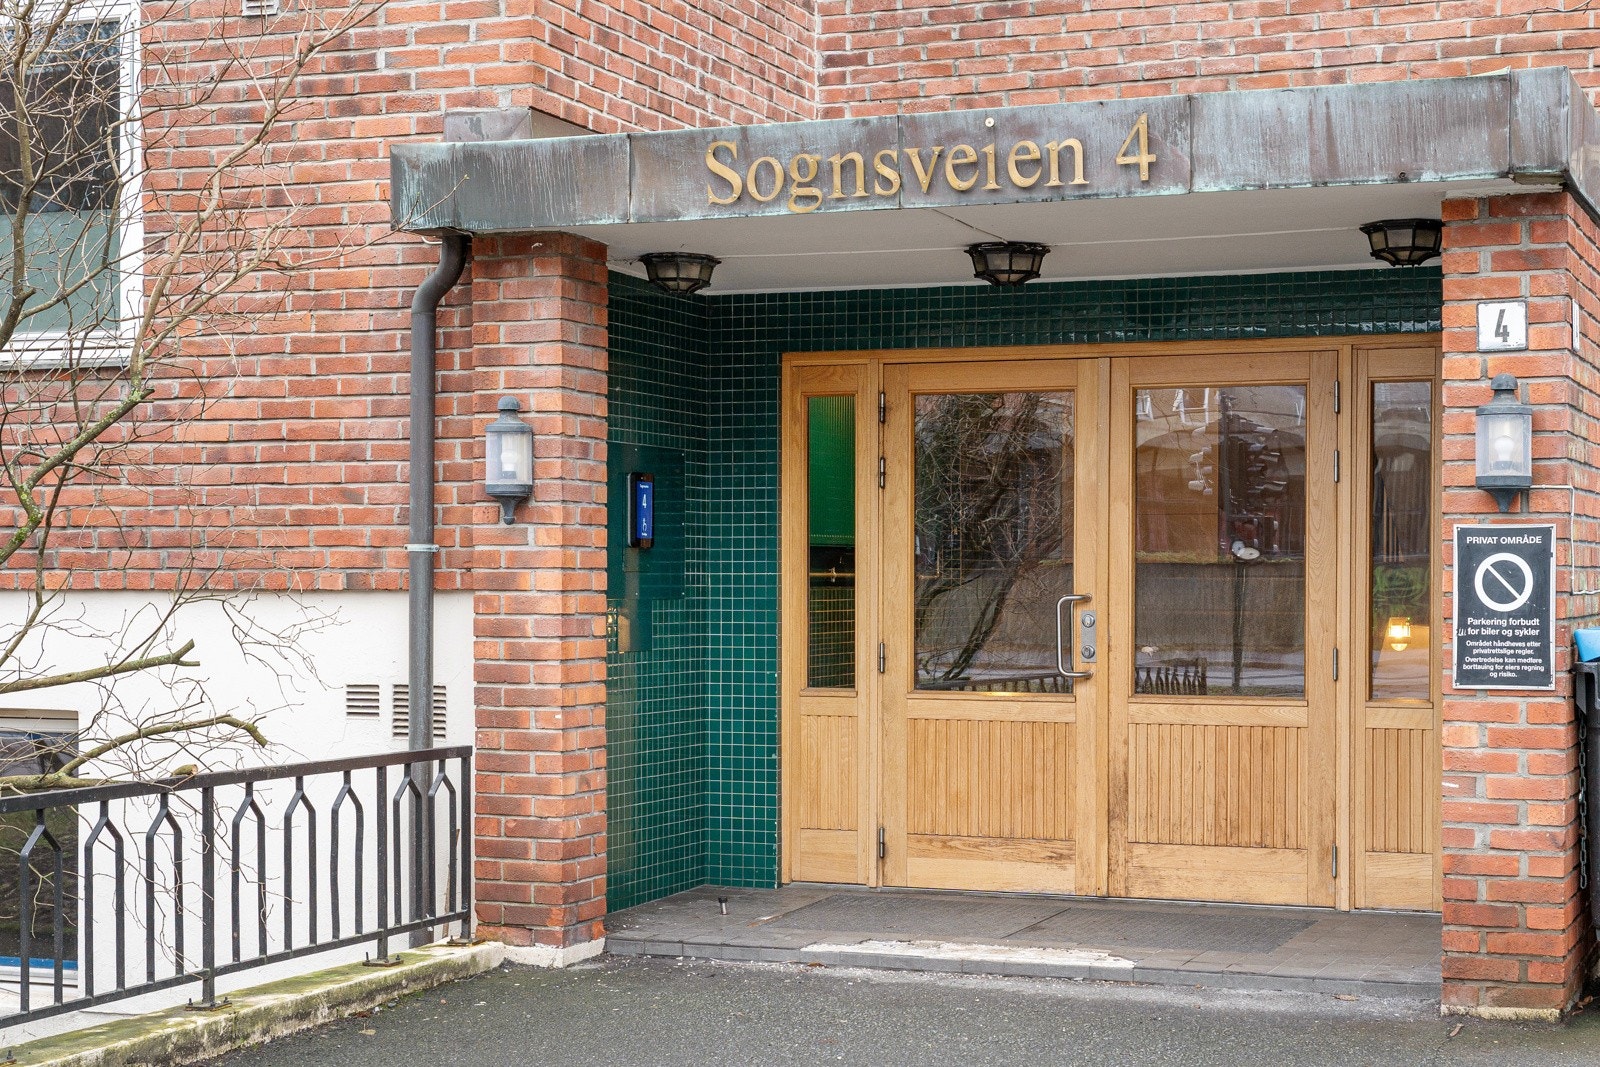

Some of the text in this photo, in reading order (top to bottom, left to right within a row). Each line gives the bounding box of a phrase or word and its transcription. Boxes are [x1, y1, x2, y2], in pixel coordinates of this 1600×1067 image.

[706, 112, 1157, 214] Sognsveien 4
[1494, 308, 1510, 343] 4
[642, 494, 648, 508] 4
[1466, 534, 1542, 544] PRIVAT OMRÅDE
[1467, 617, 1540, 627] Parkering forbudt
[1467, 627, 1540, 637] for biler og sykler
